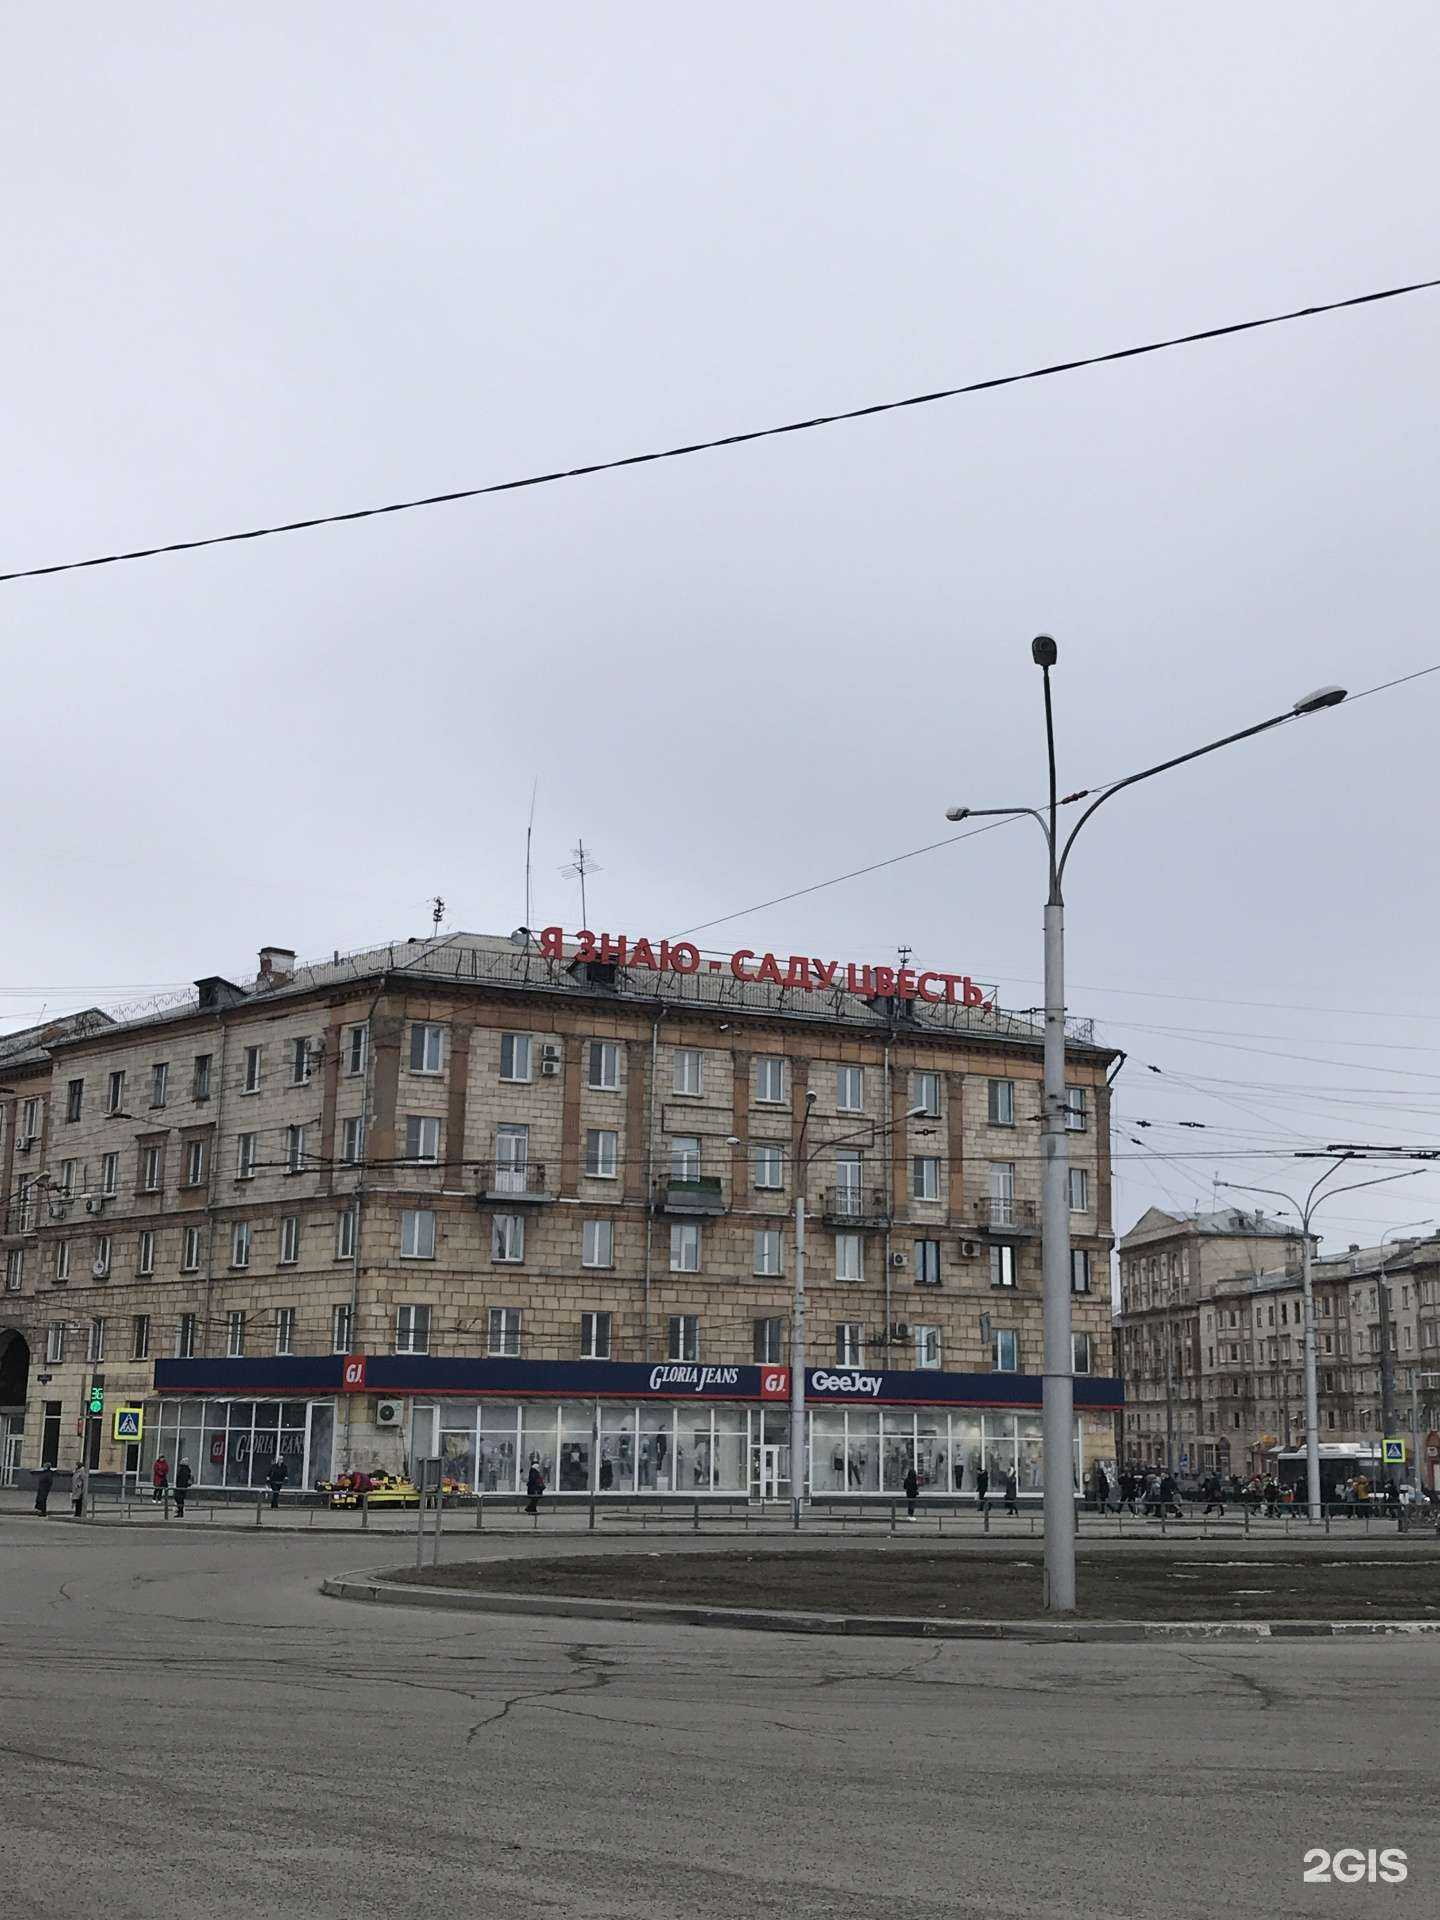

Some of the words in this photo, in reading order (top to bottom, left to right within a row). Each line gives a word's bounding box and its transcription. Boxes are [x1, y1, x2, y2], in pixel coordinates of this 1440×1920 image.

[540, 926, 563, 960] Я
[575, 930, 700, 975] ЗНАЮ
[731, 950, 838, 993] САДУ
[649, 1366, 698, 1390] GLORIA
[695, 1367, 739, 1391] JEANS
[812, 1371, 883, 1396] GeeJay
[91, 1387, 103, 1400] 36
